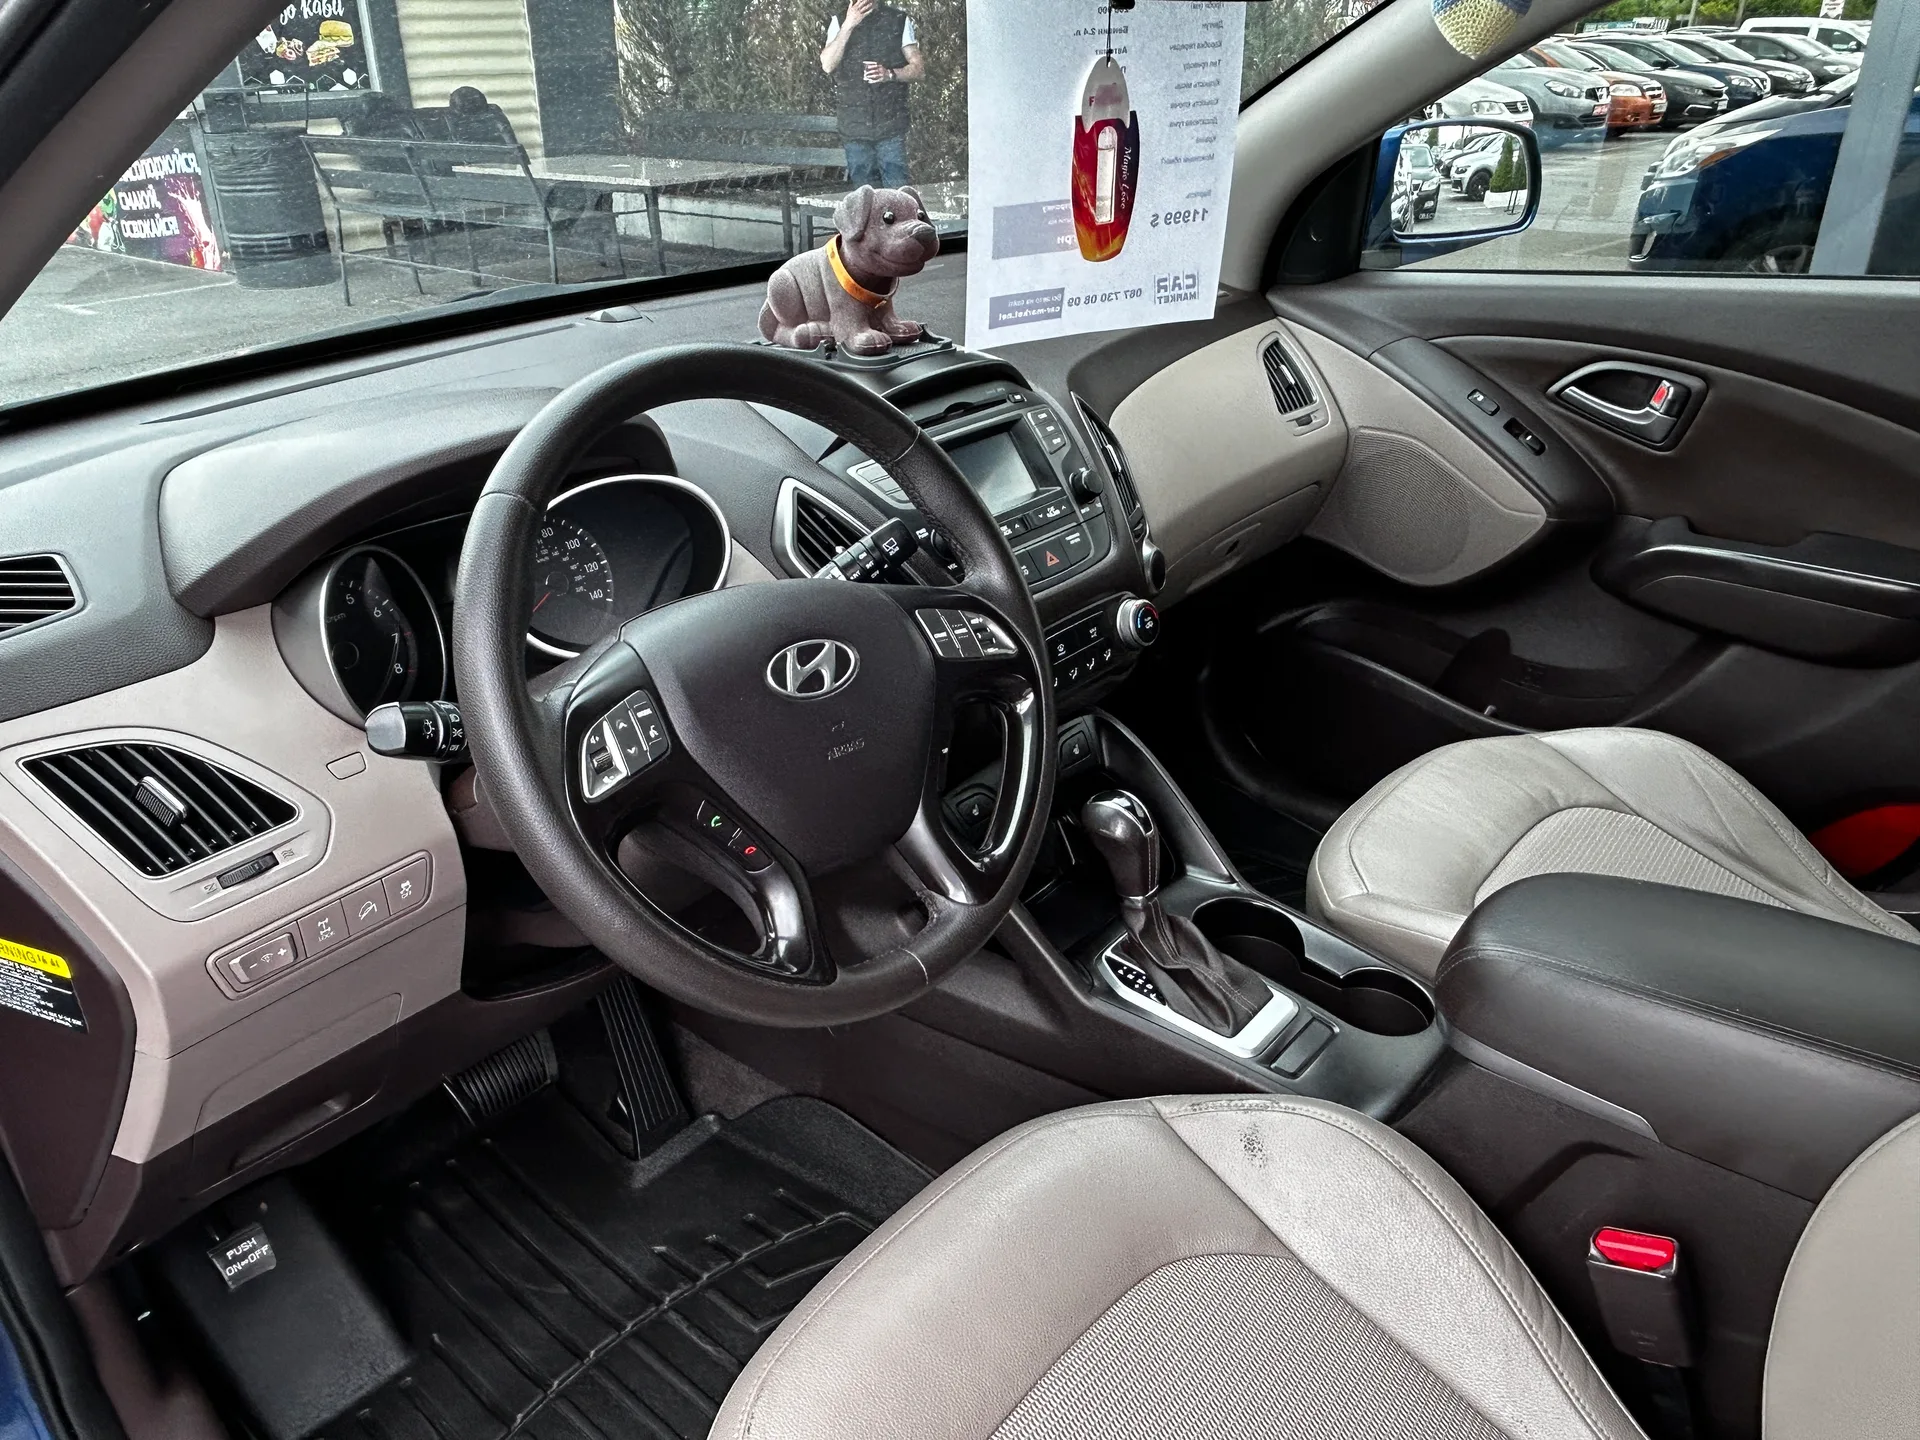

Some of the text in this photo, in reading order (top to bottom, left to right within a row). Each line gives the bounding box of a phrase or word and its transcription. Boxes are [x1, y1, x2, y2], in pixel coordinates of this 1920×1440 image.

[541, 527, 554, 538] 80
[565, 538, 581, 550] 100
[583, 561, 599, 573] 120
[345, 593, 355, 605] 5
[589, 588, 604, 601] 140
[373, 606, 383, 618] 6
[394, 662, 403, 674] 8
[226, 1237, 257, 1260] PUSH
